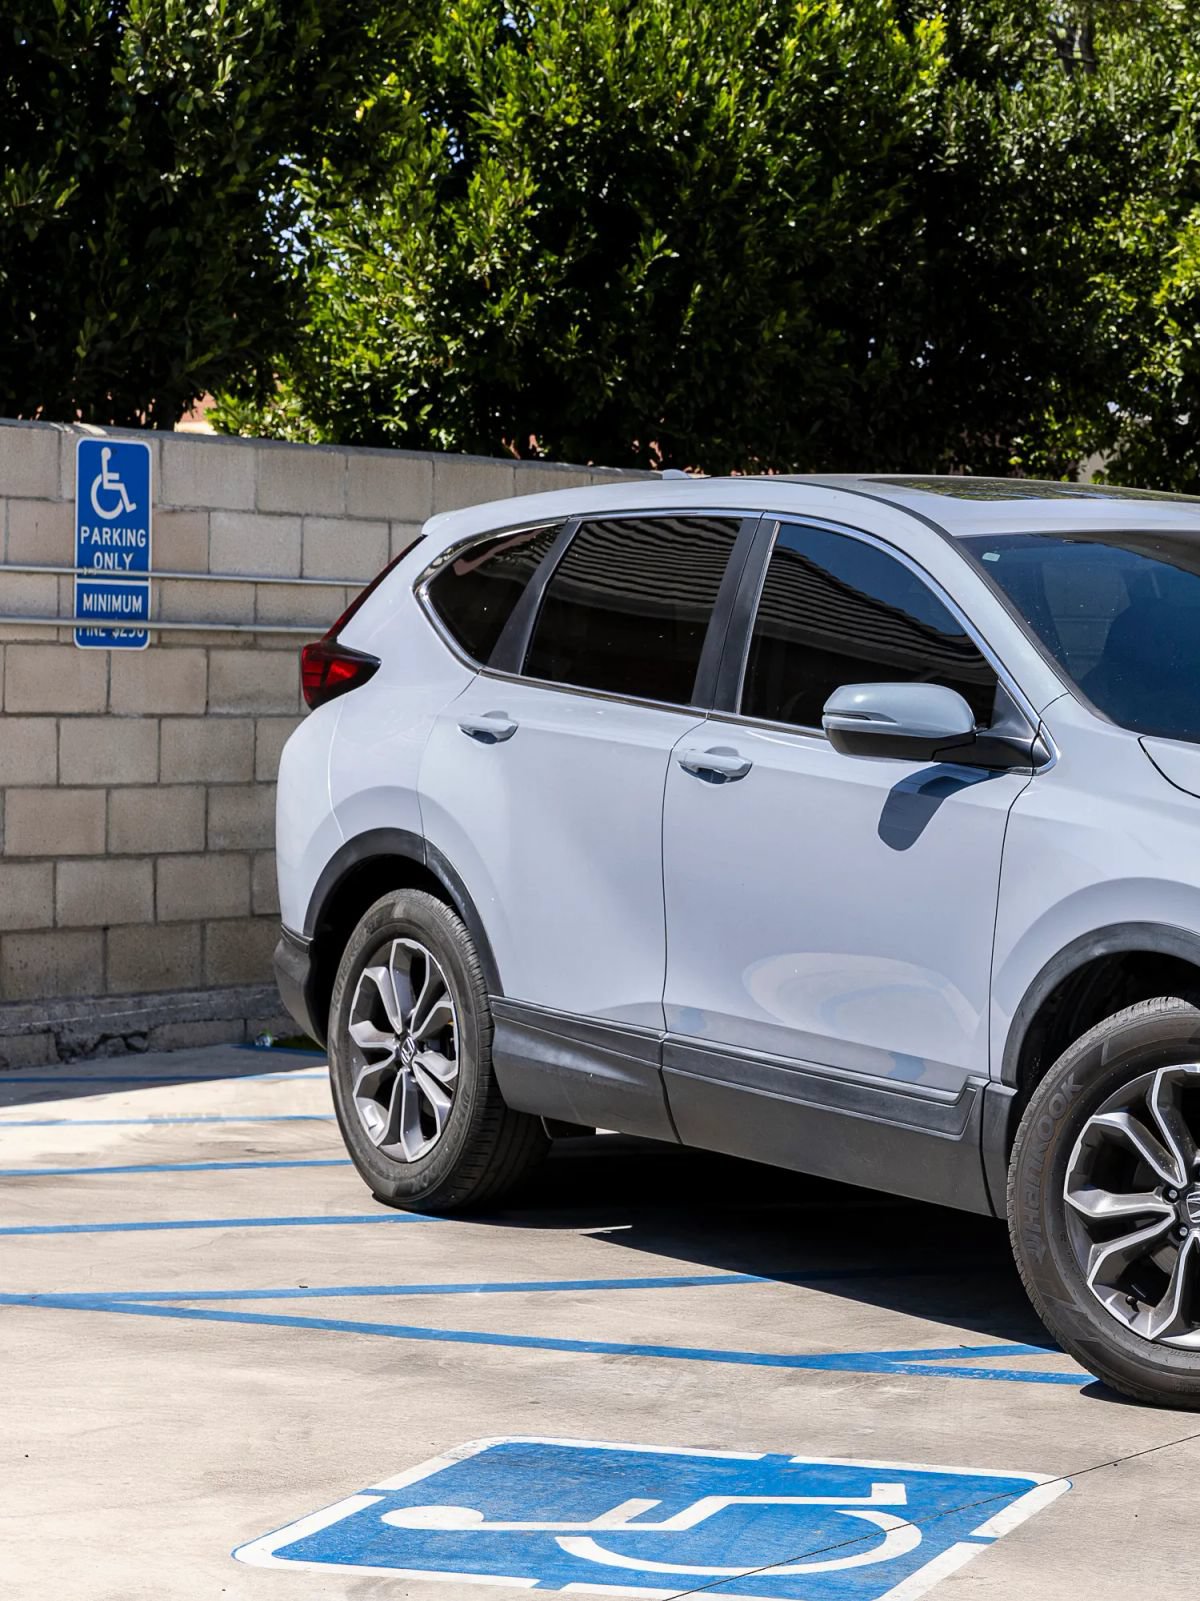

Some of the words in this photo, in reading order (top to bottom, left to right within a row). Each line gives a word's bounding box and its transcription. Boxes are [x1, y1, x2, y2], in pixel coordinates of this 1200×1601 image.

[80, 526, 146, 548] PARKING
[93, 552, 133, 571] ONLY
[83, 593, 142, 613] MINIMUM
